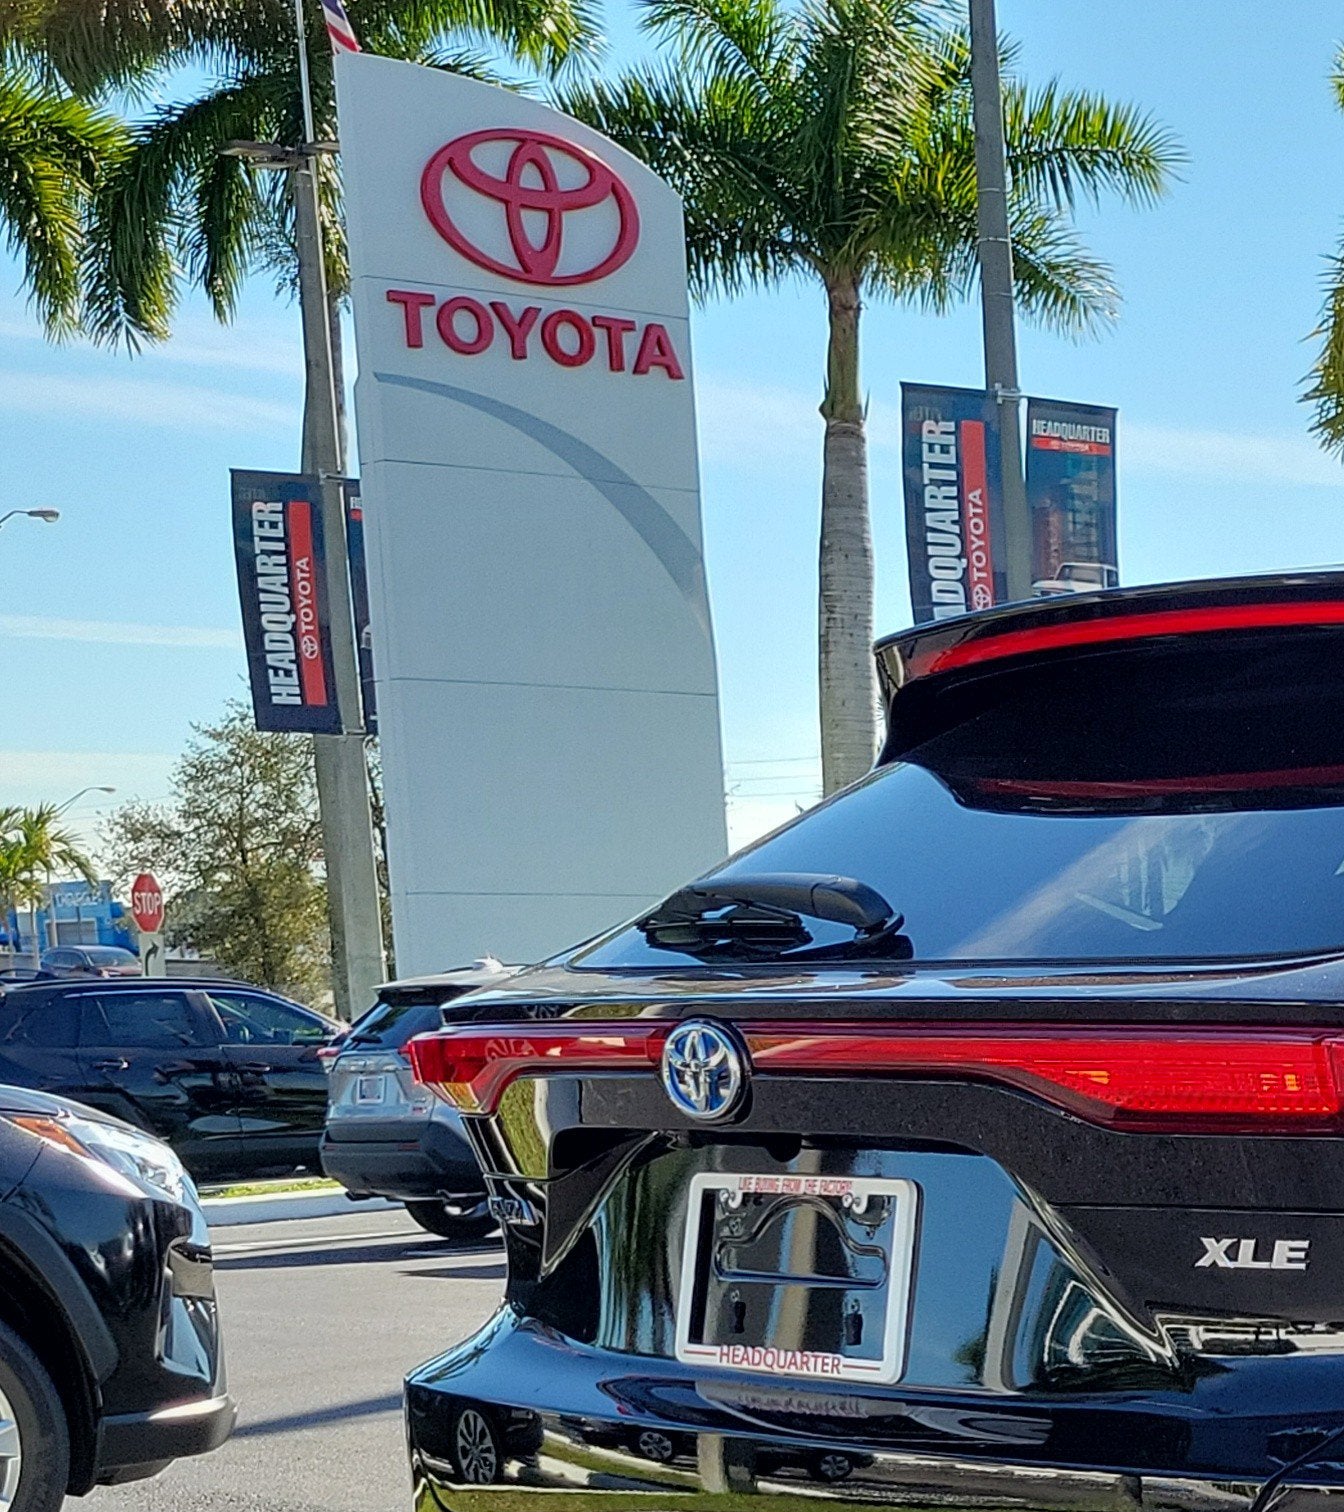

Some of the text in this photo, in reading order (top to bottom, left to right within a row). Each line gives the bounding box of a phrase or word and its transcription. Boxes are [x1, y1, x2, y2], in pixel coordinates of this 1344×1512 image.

[386, 290, 685, 380] TOYOTA
[1032, 419, 1110, 444] HEADQUARTER
[921, 419, 968, 620] DQUARTER
[967, 488, 986, 581] TOYOTA
[252, 501, 303, 706] HEADQUARTER
[295, 556, 316, 634] TOYOTA
[133, 891, 162, 915] STOP
[1194, 1236, 1310, 1270] XLE
[719, 1345, 842, 1375] HEADQUARTER
